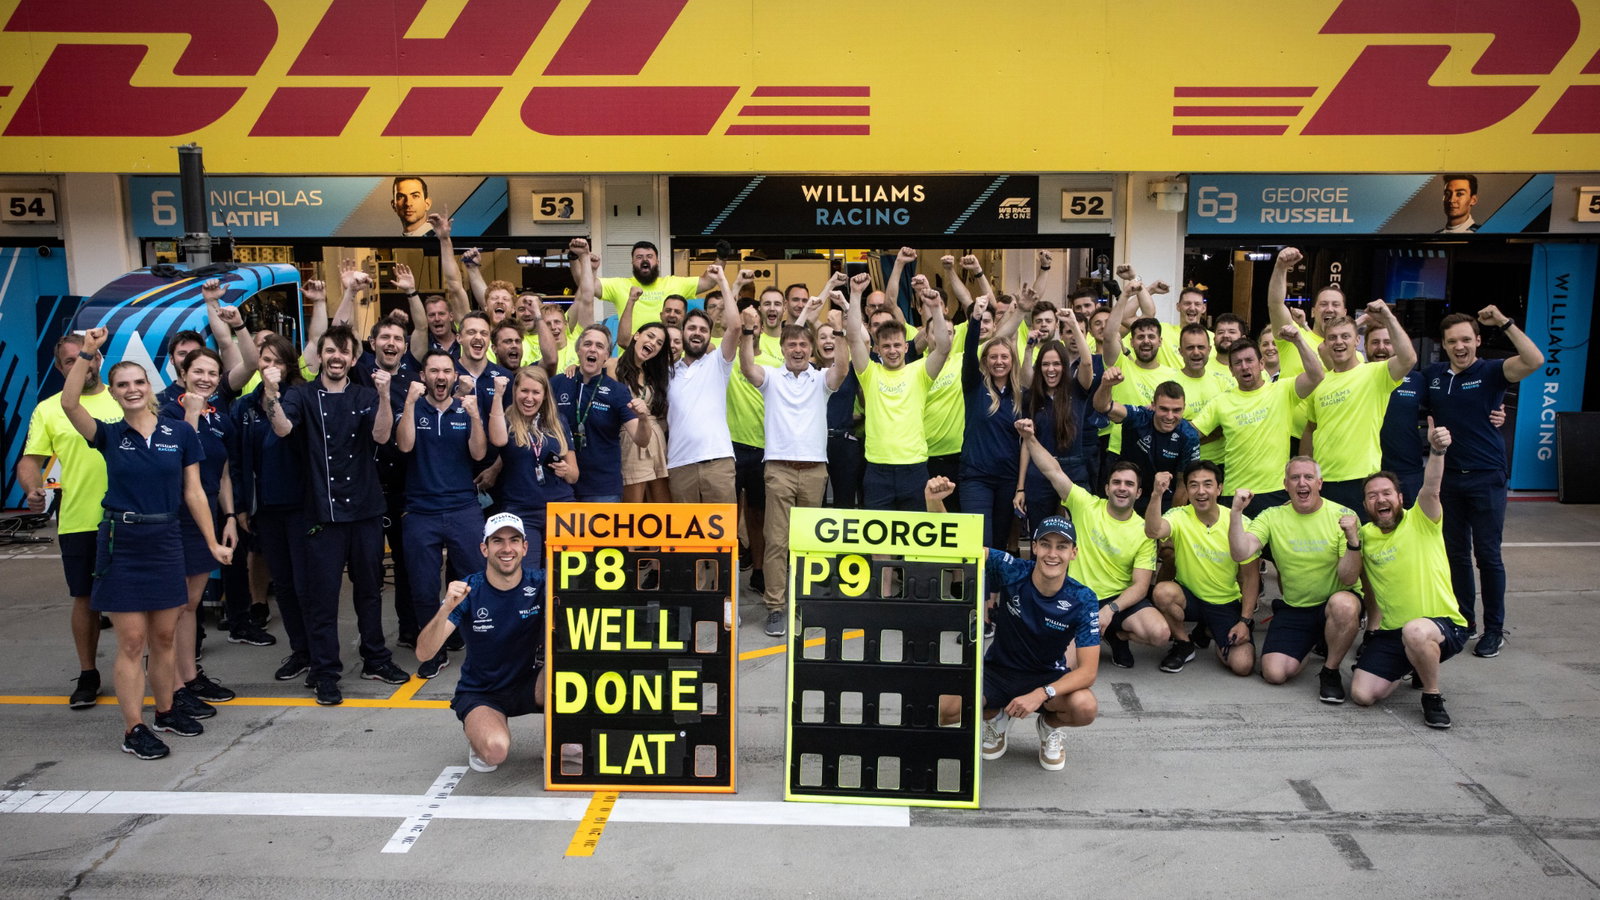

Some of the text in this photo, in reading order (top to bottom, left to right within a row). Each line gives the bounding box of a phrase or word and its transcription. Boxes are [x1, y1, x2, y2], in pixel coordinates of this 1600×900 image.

[3, 0, 740, 136] DHL
[210, 190, 323, 206] NICHOLAS
[801, 185, 926, 202] WILLIAMS
[1197, 186, 1238, 224] 63
[1262, 187, 1349, 203] GEORGE
[9, 197, 46, 217] 54
[151, 190, 177, 226] 6
[816, 208, 911, 225] RACING
[1070, 196, 1104, 215] 52
[1260, 208, 1354, 223] RUSSELL
[211, 211, 279, 227] LATIFI
[1537, 273, 1570, 461] WILLIAMS RACING
[555, 513, 725, 539] NICHOLAS
[814, 517, 958, 548] GEORGE
[1044, 518, 1072, 529] WILLIAMS
[1045, 522, 1069, 531] RACING
[560, 548, 626, 591] P8
[802, 554, 871, 597] P9
[566, 607, 684, 651] WELL
[1045, 616, 1069, 629] WILLIAMS
[555, 670, 698, 714] DONE
[599, 733, 676, 775] LAT
